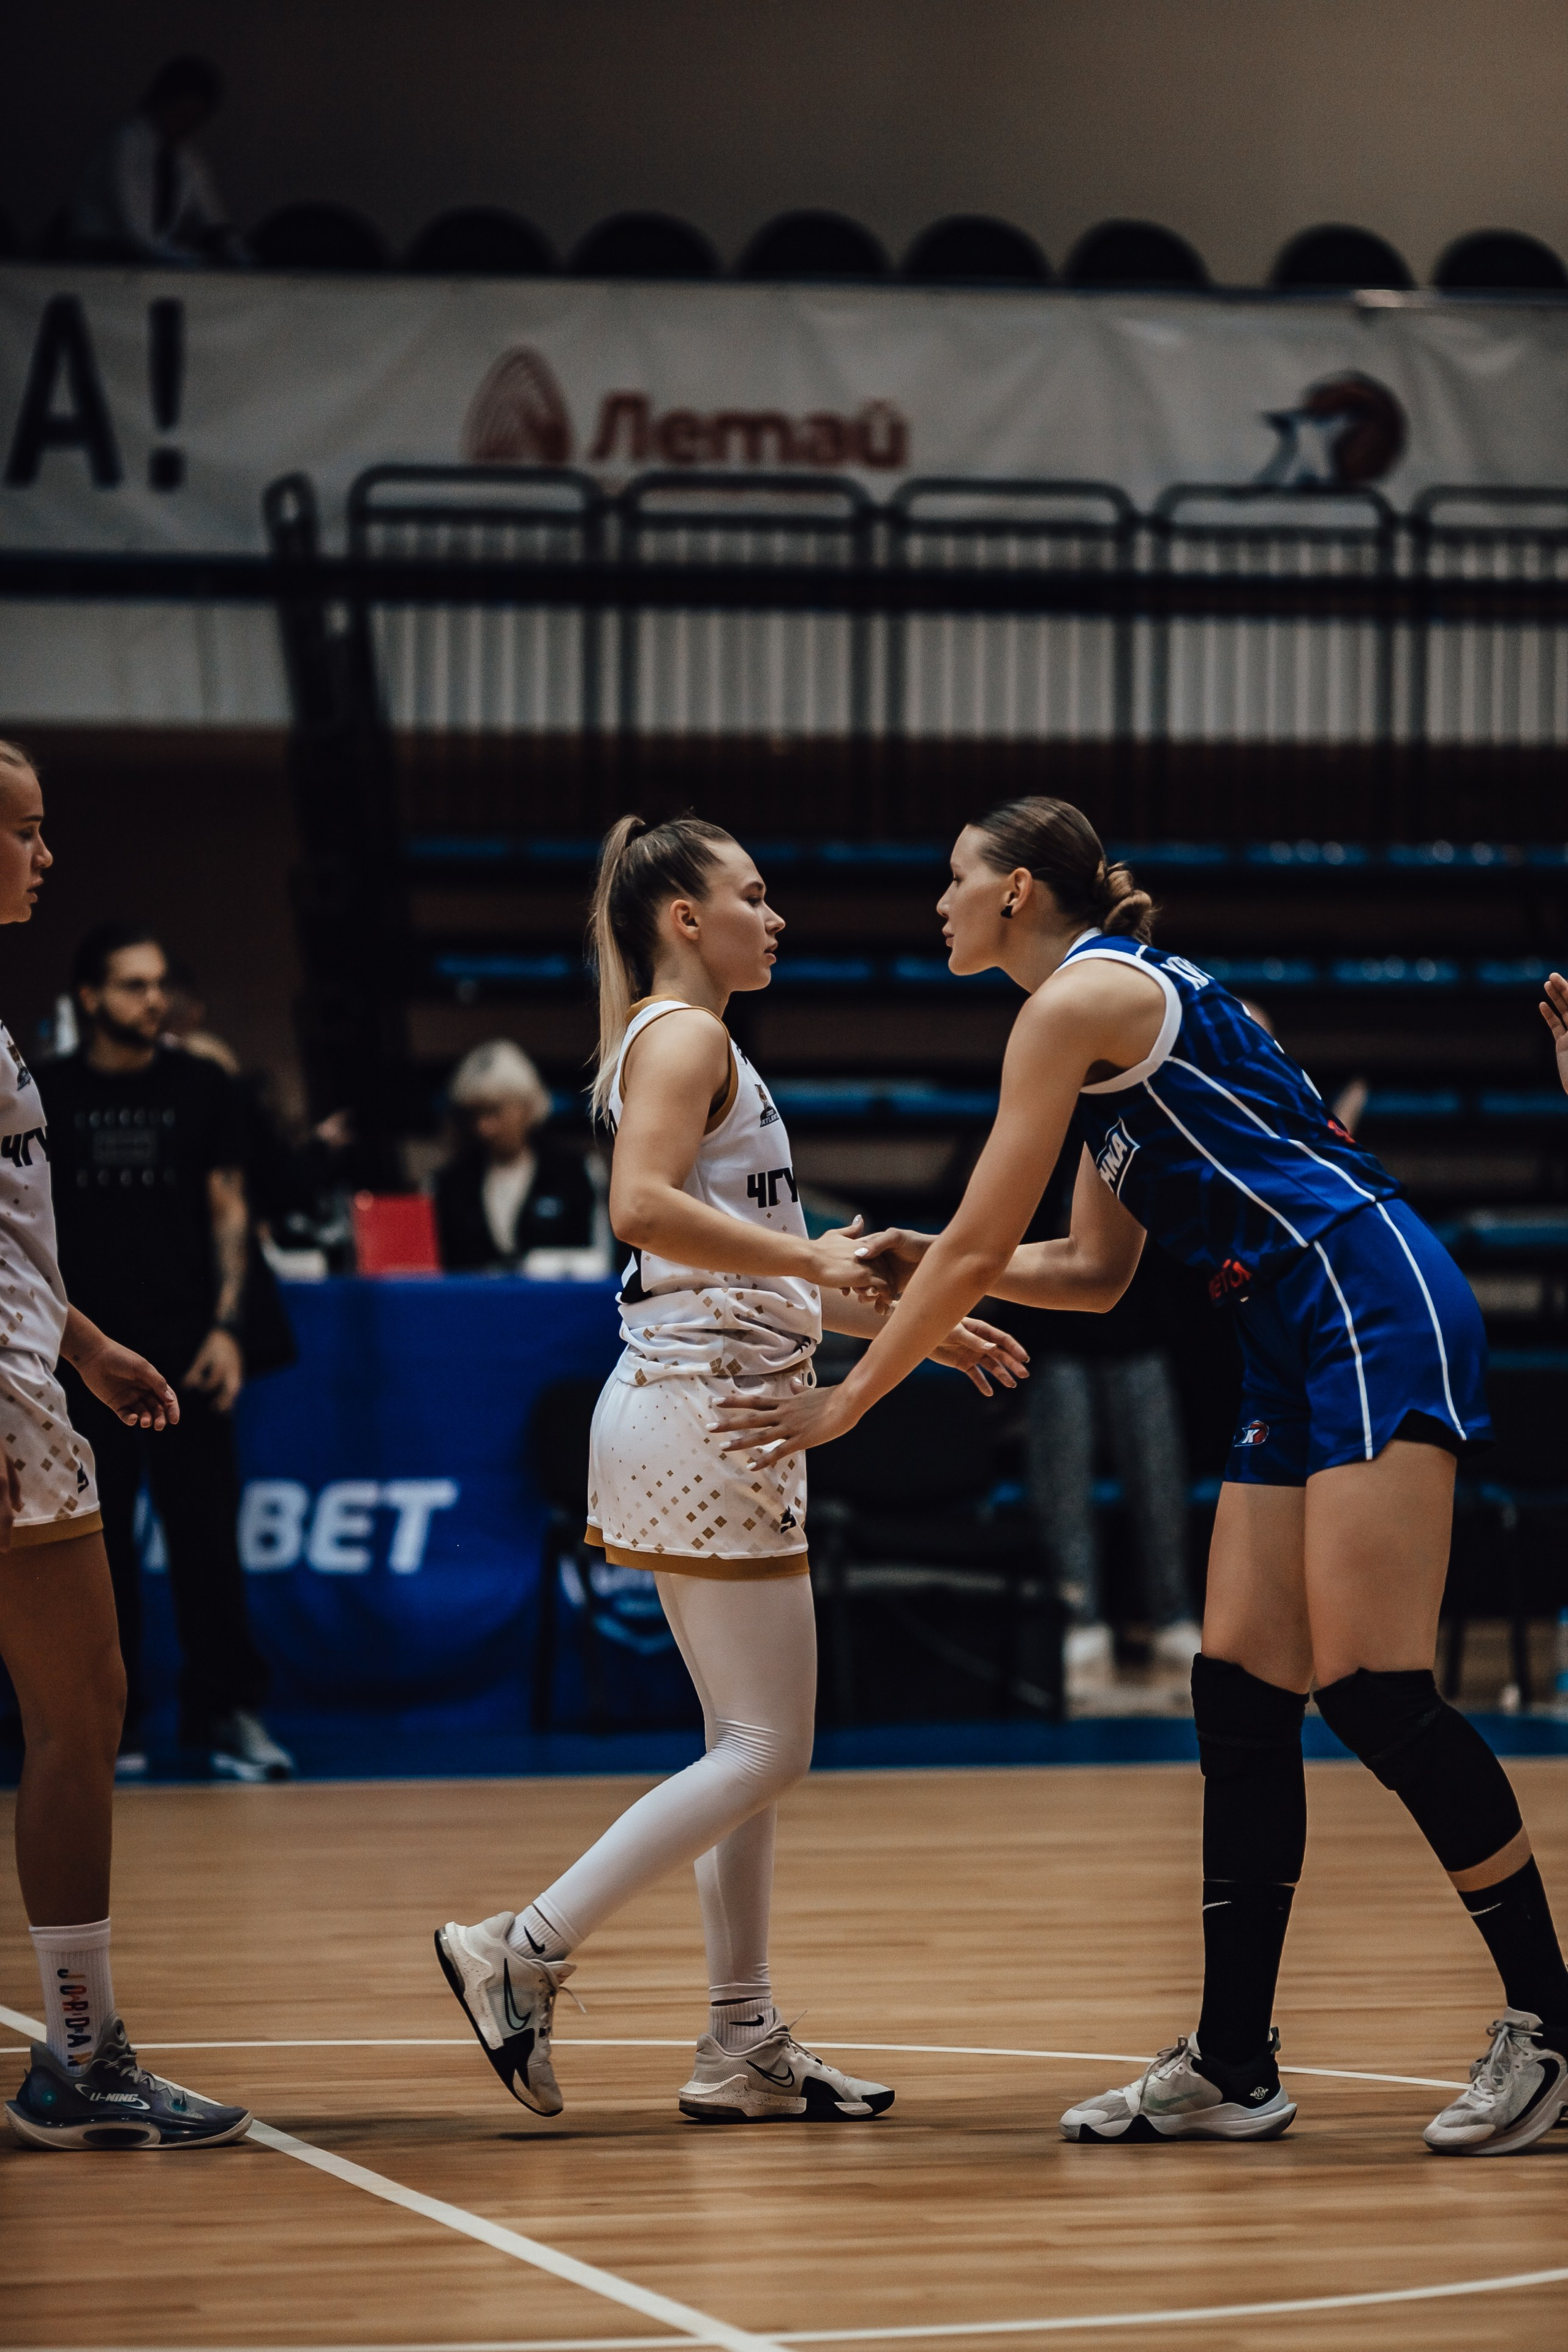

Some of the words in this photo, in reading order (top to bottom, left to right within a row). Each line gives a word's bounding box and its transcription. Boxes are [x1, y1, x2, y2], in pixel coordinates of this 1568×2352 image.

[592, 391, 909, 469] Летай
[132, 1477, 459, 1576] BET
[57, 1968, 92, 2067] JORDAN
[89, 2092, 139, 2103] LI-NING
